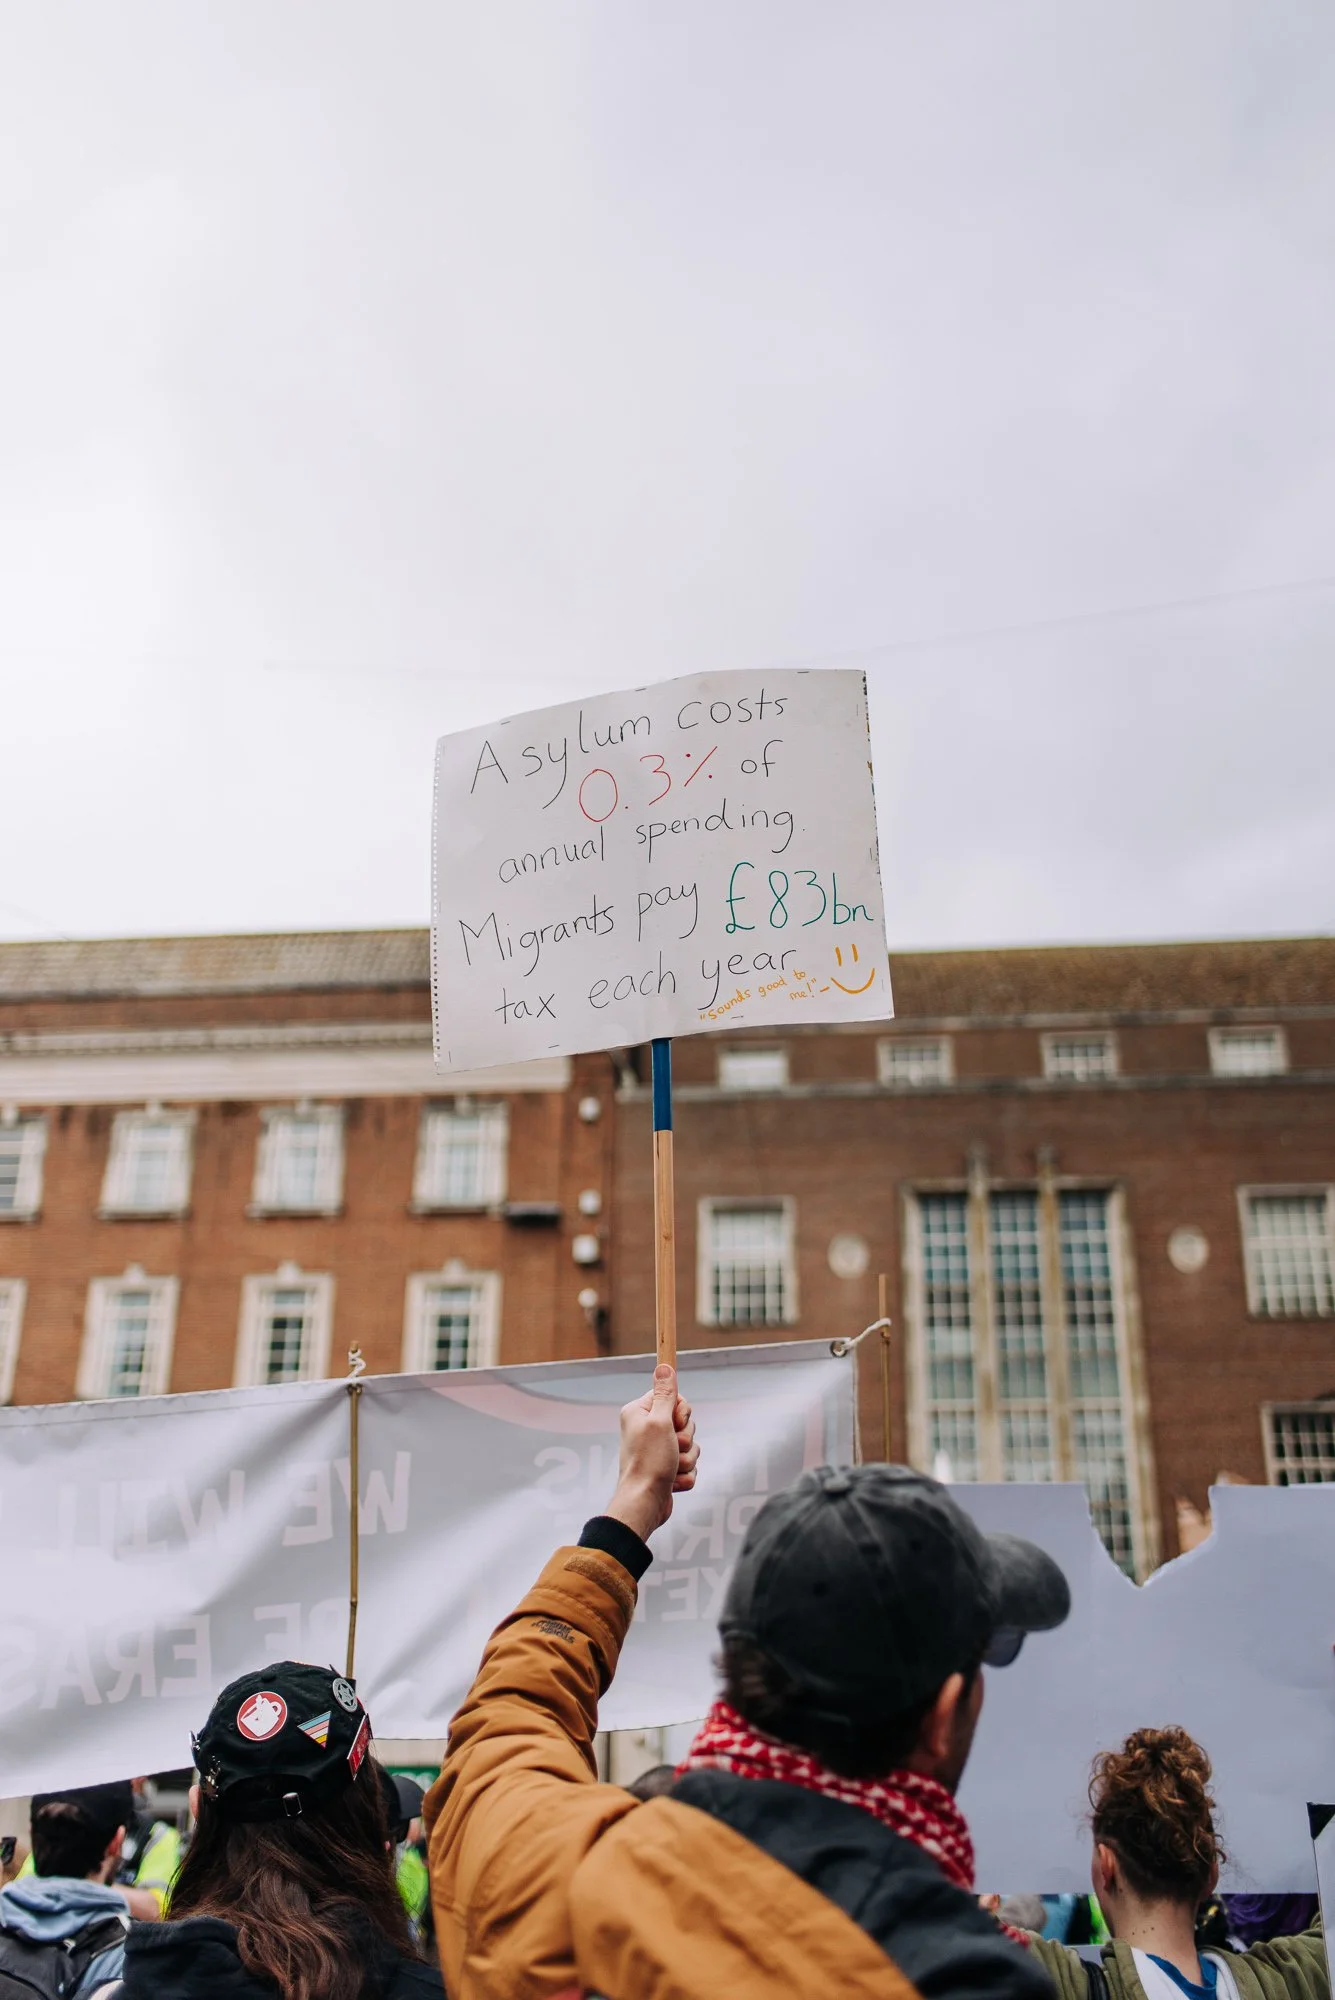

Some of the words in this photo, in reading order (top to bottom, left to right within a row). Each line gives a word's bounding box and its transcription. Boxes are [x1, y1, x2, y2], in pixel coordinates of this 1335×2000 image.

[471, 710, 650, 809] Asylum
[678, 688, 788, 729] costs
[579, 746, 718, 822] 0.3%
[740, 740, 783, 777] of
[499, 826, 604, 883] annual
[637, 798, 806, 862] spending.
[459, 894, 614, 977] Migrants
[638, 882, 698, 941] pay
[725, 862, 874, 934] £83bn
[495, 988, 556, 1024] tax
[589, 951, 676, 1009] each
[698, 948, 797, 1011] year
[758, 975, 788, 997] good
[793, 969, 805, 980] to
